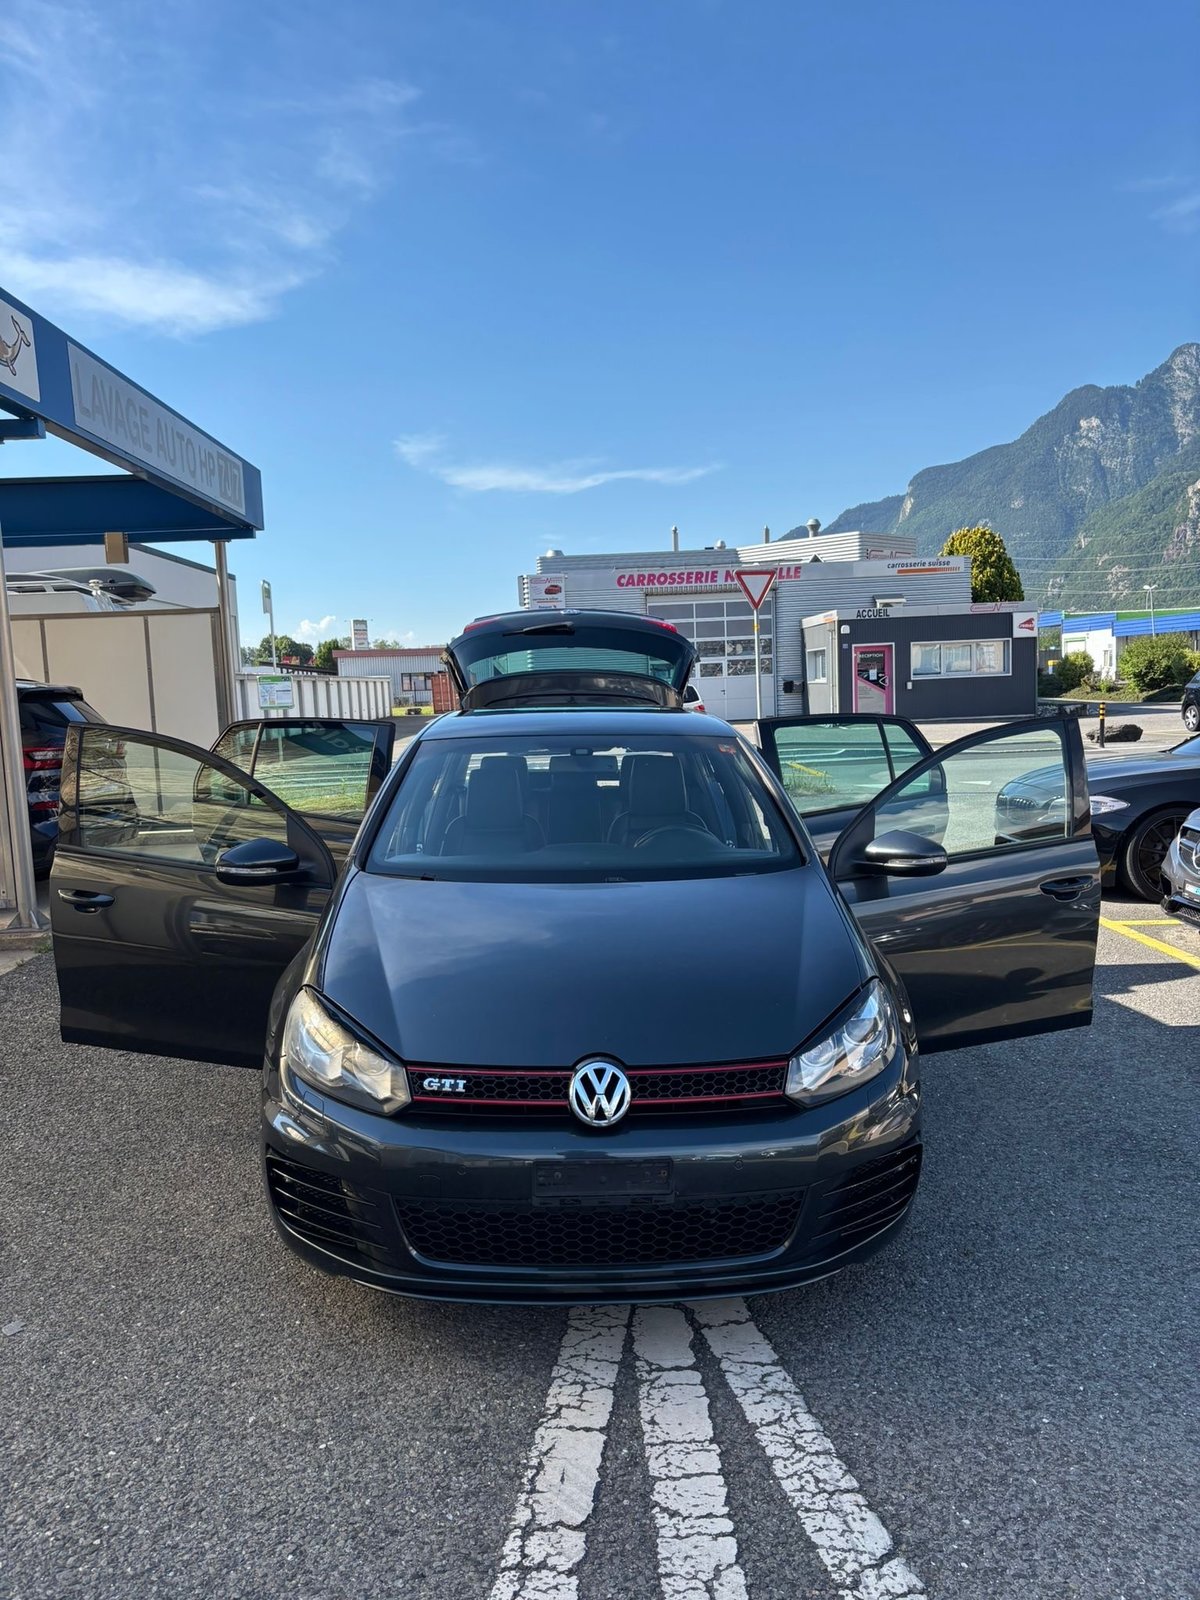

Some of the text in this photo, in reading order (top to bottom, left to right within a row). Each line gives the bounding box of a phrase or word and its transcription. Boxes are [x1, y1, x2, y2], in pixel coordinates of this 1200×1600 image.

[75, 362, 152, 454] LAVAGE
[156, 417, 196, 480] AUTO
[199, 445, 216, 488] HP
[887, 560, 926, 569] carrosserie
[616, 565, 802, 588] CARROSSERIE NLLE
[856, 608, 890, 619] ACCUEIL
[422, 1076, 467, 1093] GTI
